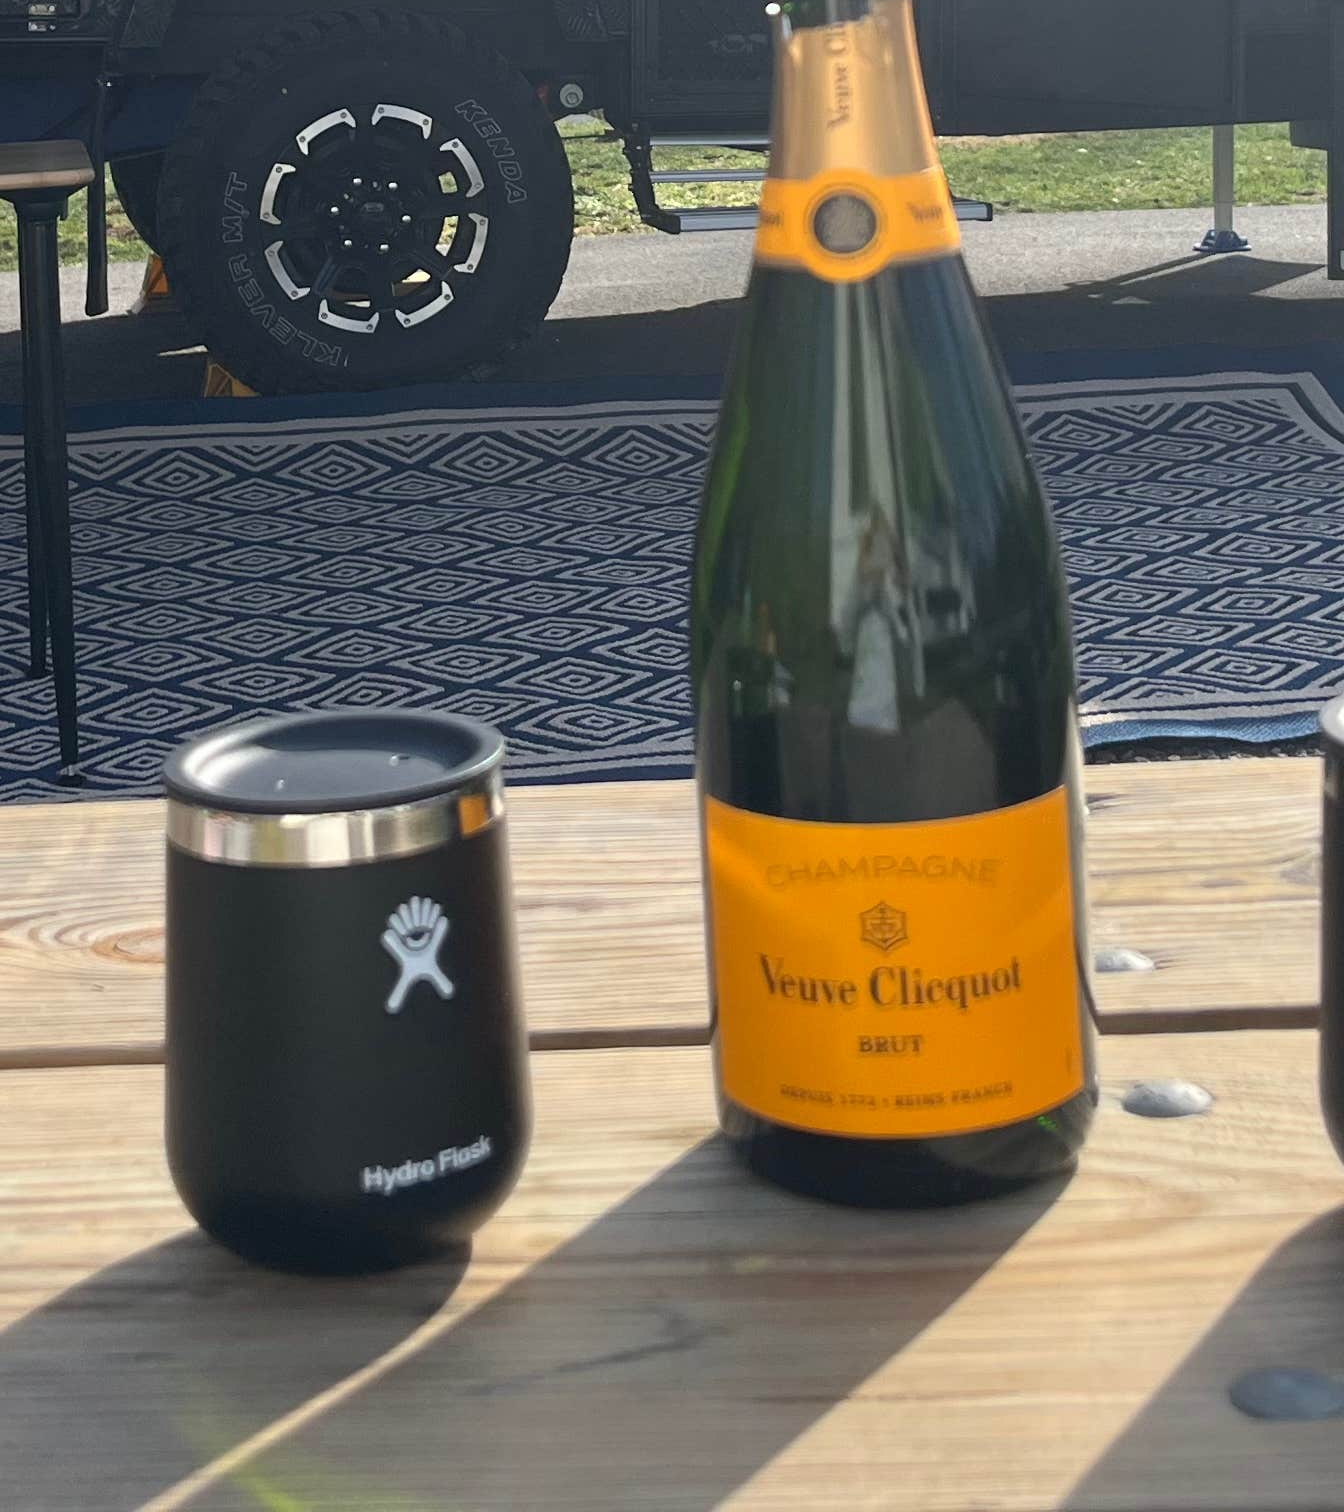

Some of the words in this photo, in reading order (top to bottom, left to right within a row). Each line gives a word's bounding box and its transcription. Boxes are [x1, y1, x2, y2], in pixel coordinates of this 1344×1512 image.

[454, 99, 528, 204] KENDA
[222, 171, 249, 244] M/T
[228, 253, 343, 367] KLEVER
[765, 855, 1002, 888] CHAMPAGNE
[758, 952, 857, 1006] Veuve
[869, 955, 1022, 1011] Clicquot
[858, 1035, 924, 1054] BRUT
[363, 1159, 435, 1196] Hydro
[438, 1135, 491, 1173] Flask
